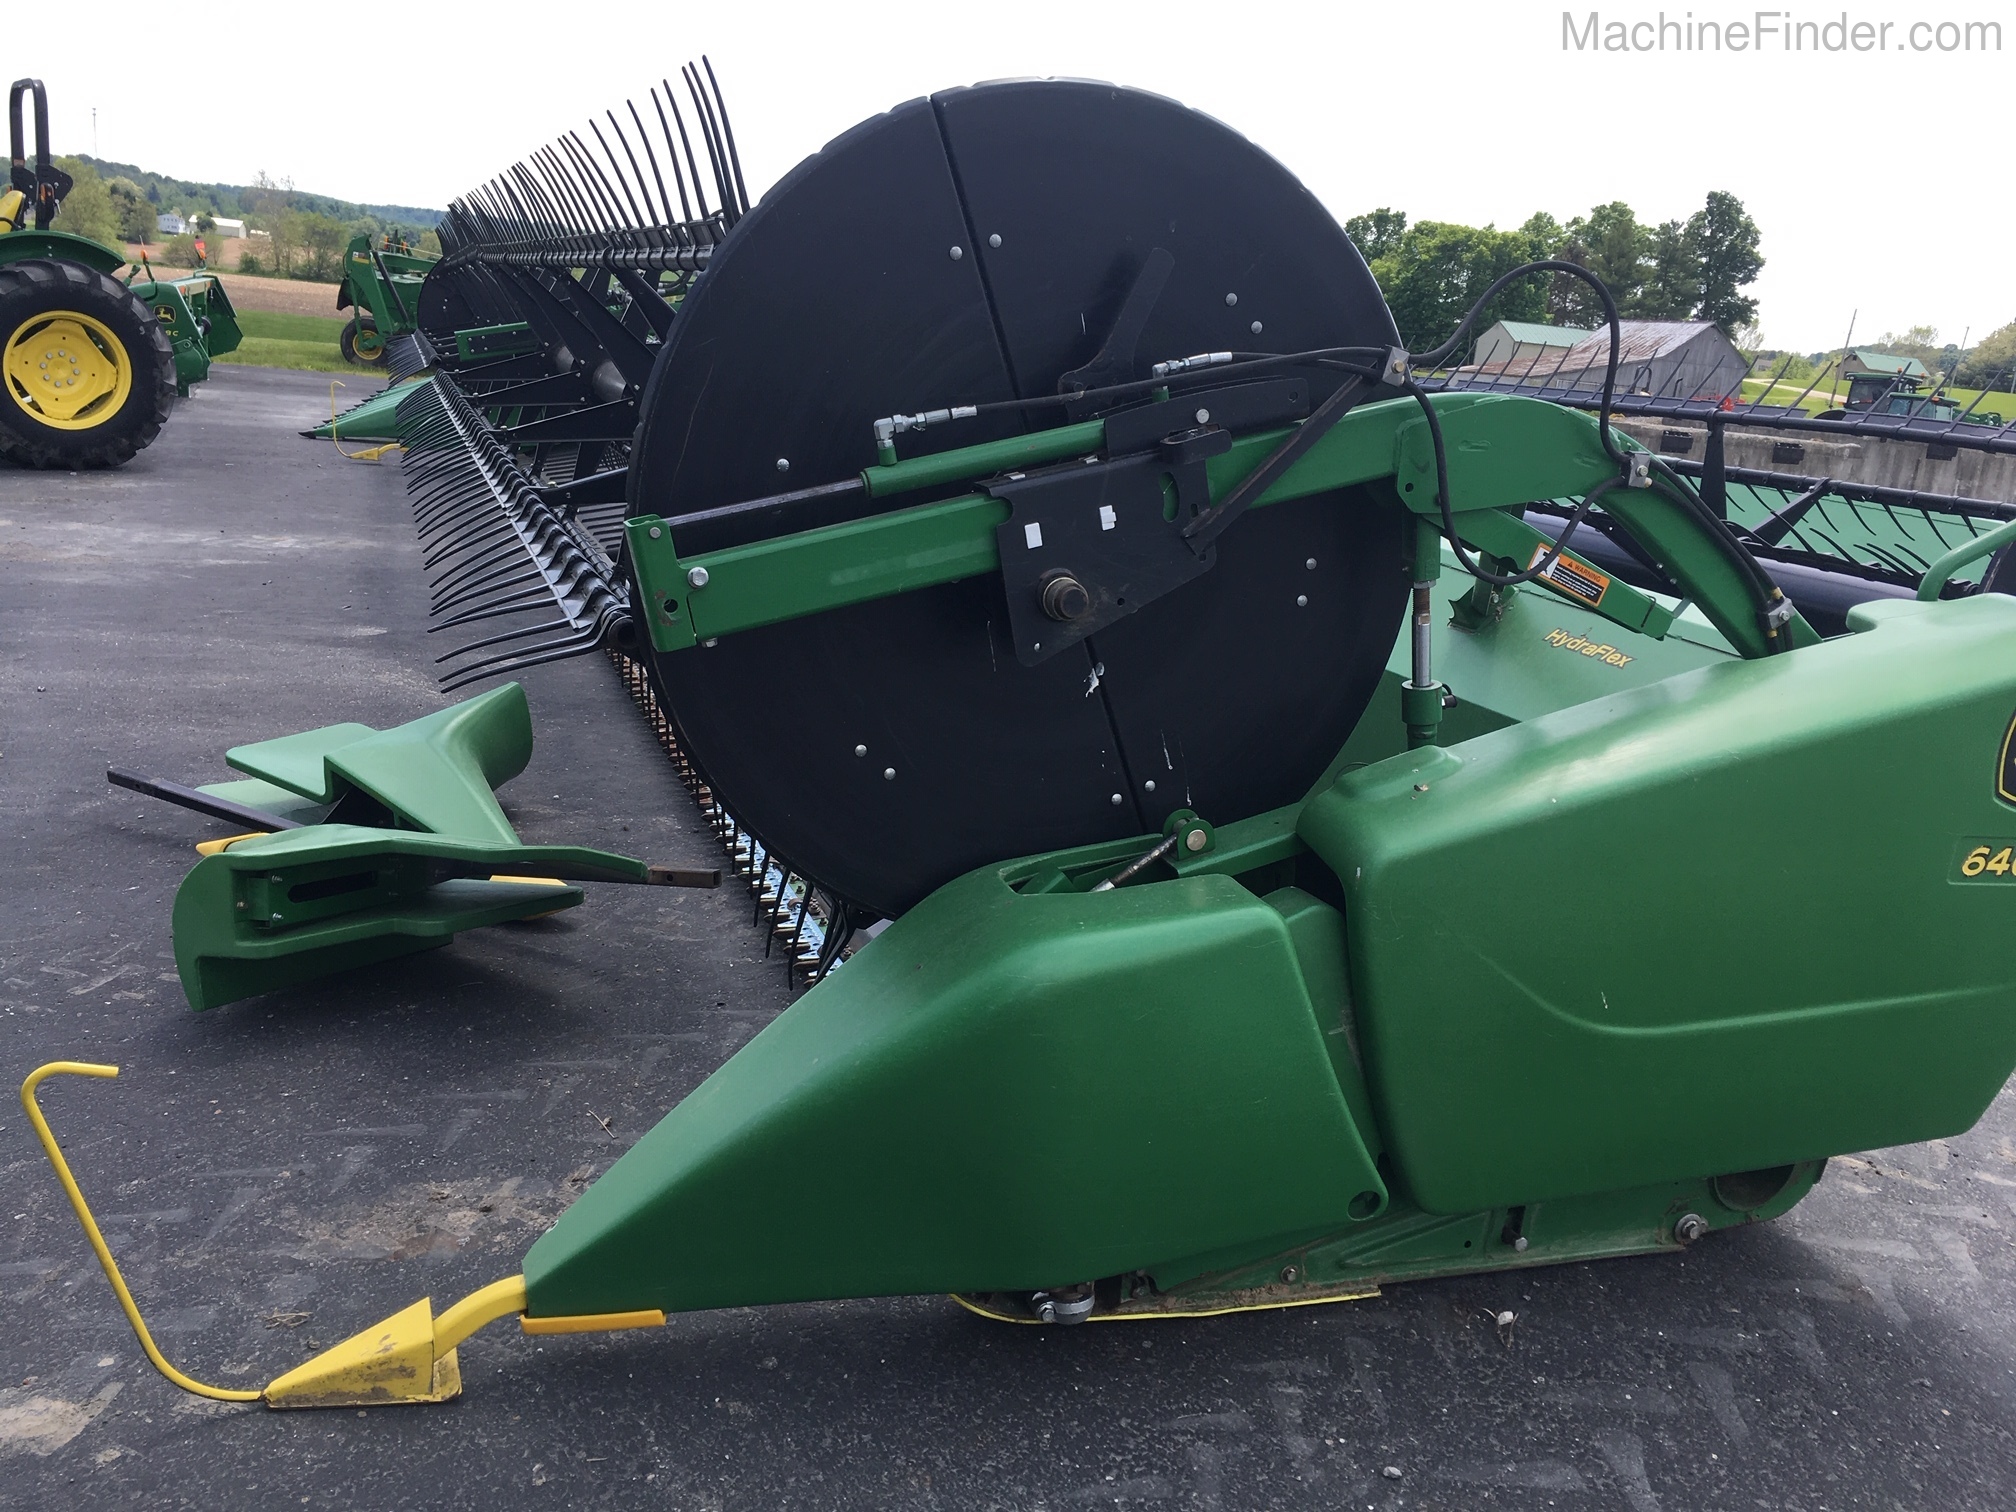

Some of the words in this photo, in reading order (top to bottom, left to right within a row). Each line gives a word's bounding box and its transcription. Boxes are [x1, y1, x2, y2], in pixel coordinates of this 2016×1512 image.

[1574, 565, 1601, 582] WARNING
[1544, 628, 1634, 668] HydraFlex
[1961, 845, 2016, 877] 64
